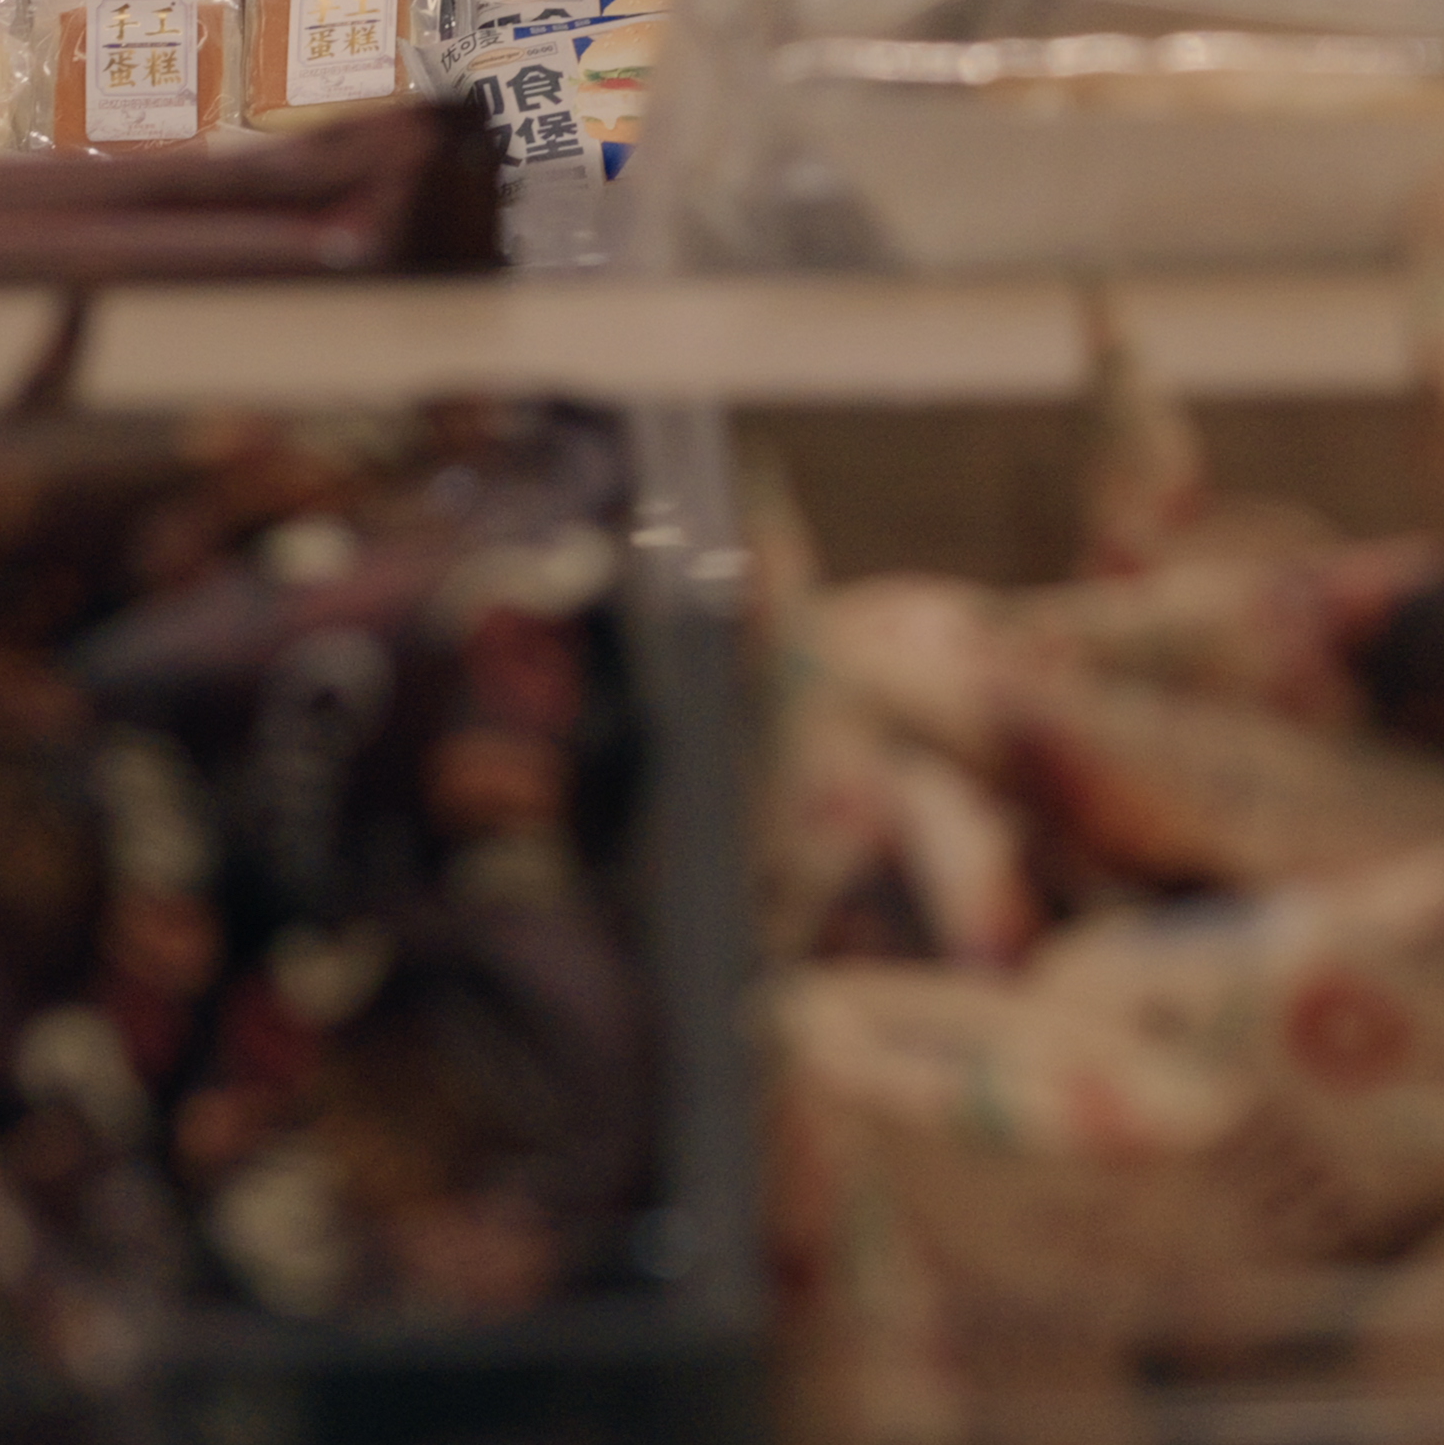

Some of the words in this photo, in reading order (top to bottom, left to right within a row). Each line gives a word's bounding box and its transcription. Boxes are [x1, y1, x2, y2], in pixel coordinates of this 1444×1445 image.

[103, 3, 182, 41] 手工
[303, 26, 380, 61] 蛋糕
[439, 27, 505, 73] 优可麦
[102, 49, 182, 89] 蛋糕
